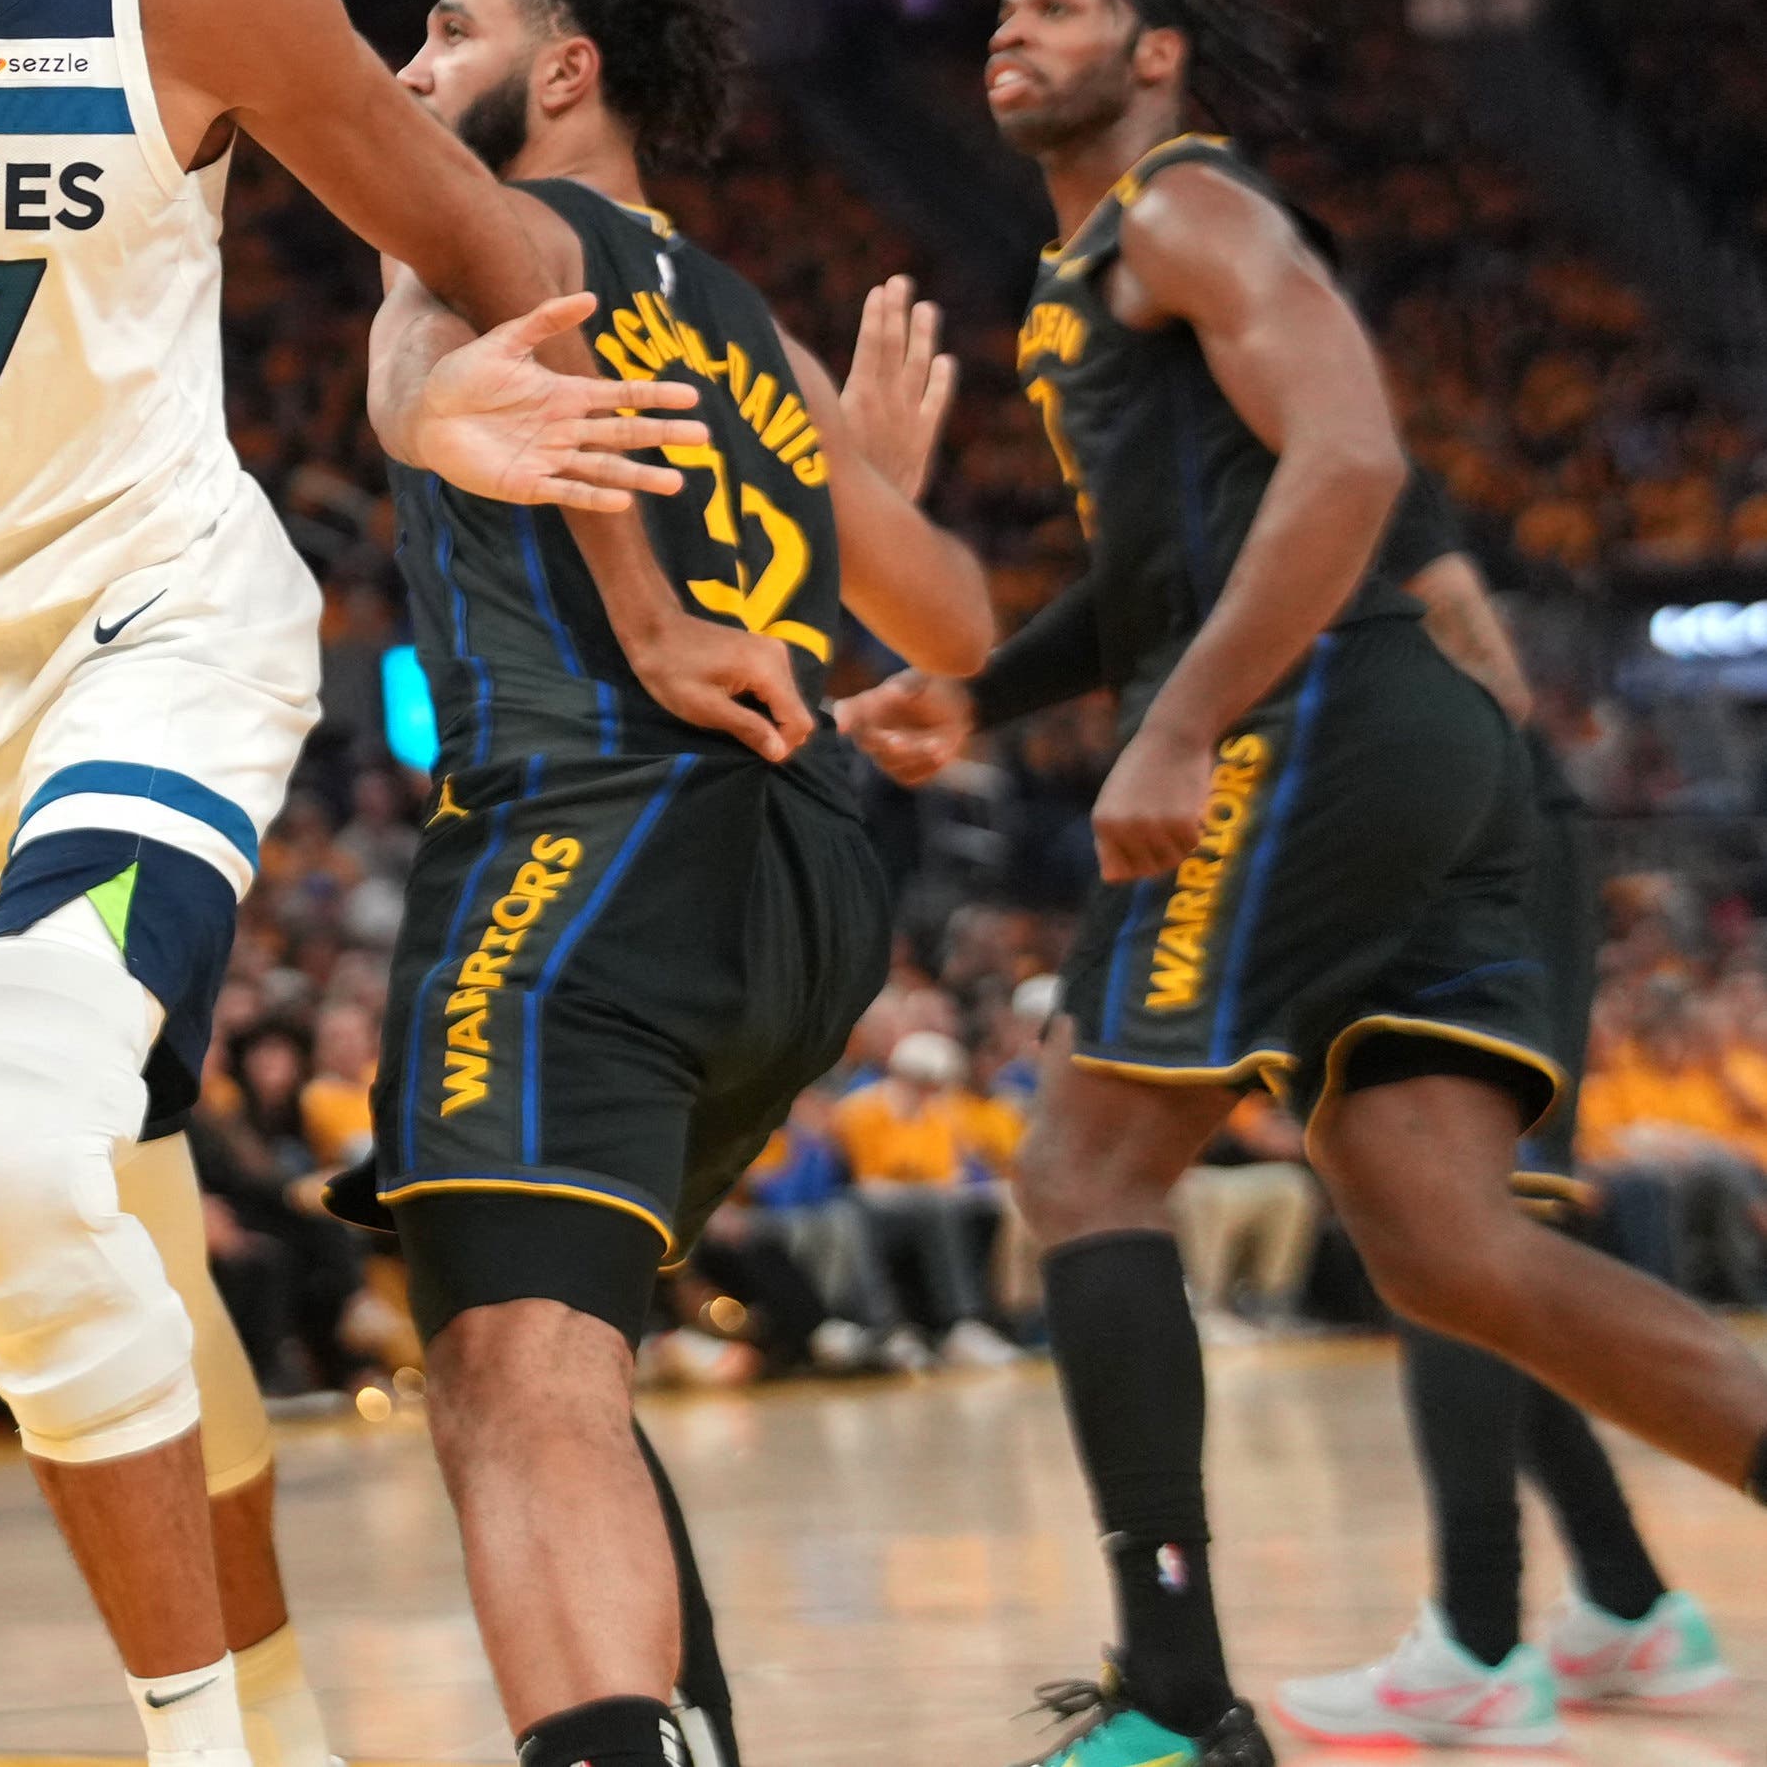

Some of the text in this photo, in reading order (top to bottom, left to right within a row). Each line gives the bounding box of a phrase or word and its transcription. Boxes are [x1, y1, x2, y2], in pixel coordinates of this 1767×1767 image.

[8, 52, 90, 75] sezzle
[440, 833, 583, 1117] WARRIORS
[1143, 733, 1263, 1009] WARRIORS
